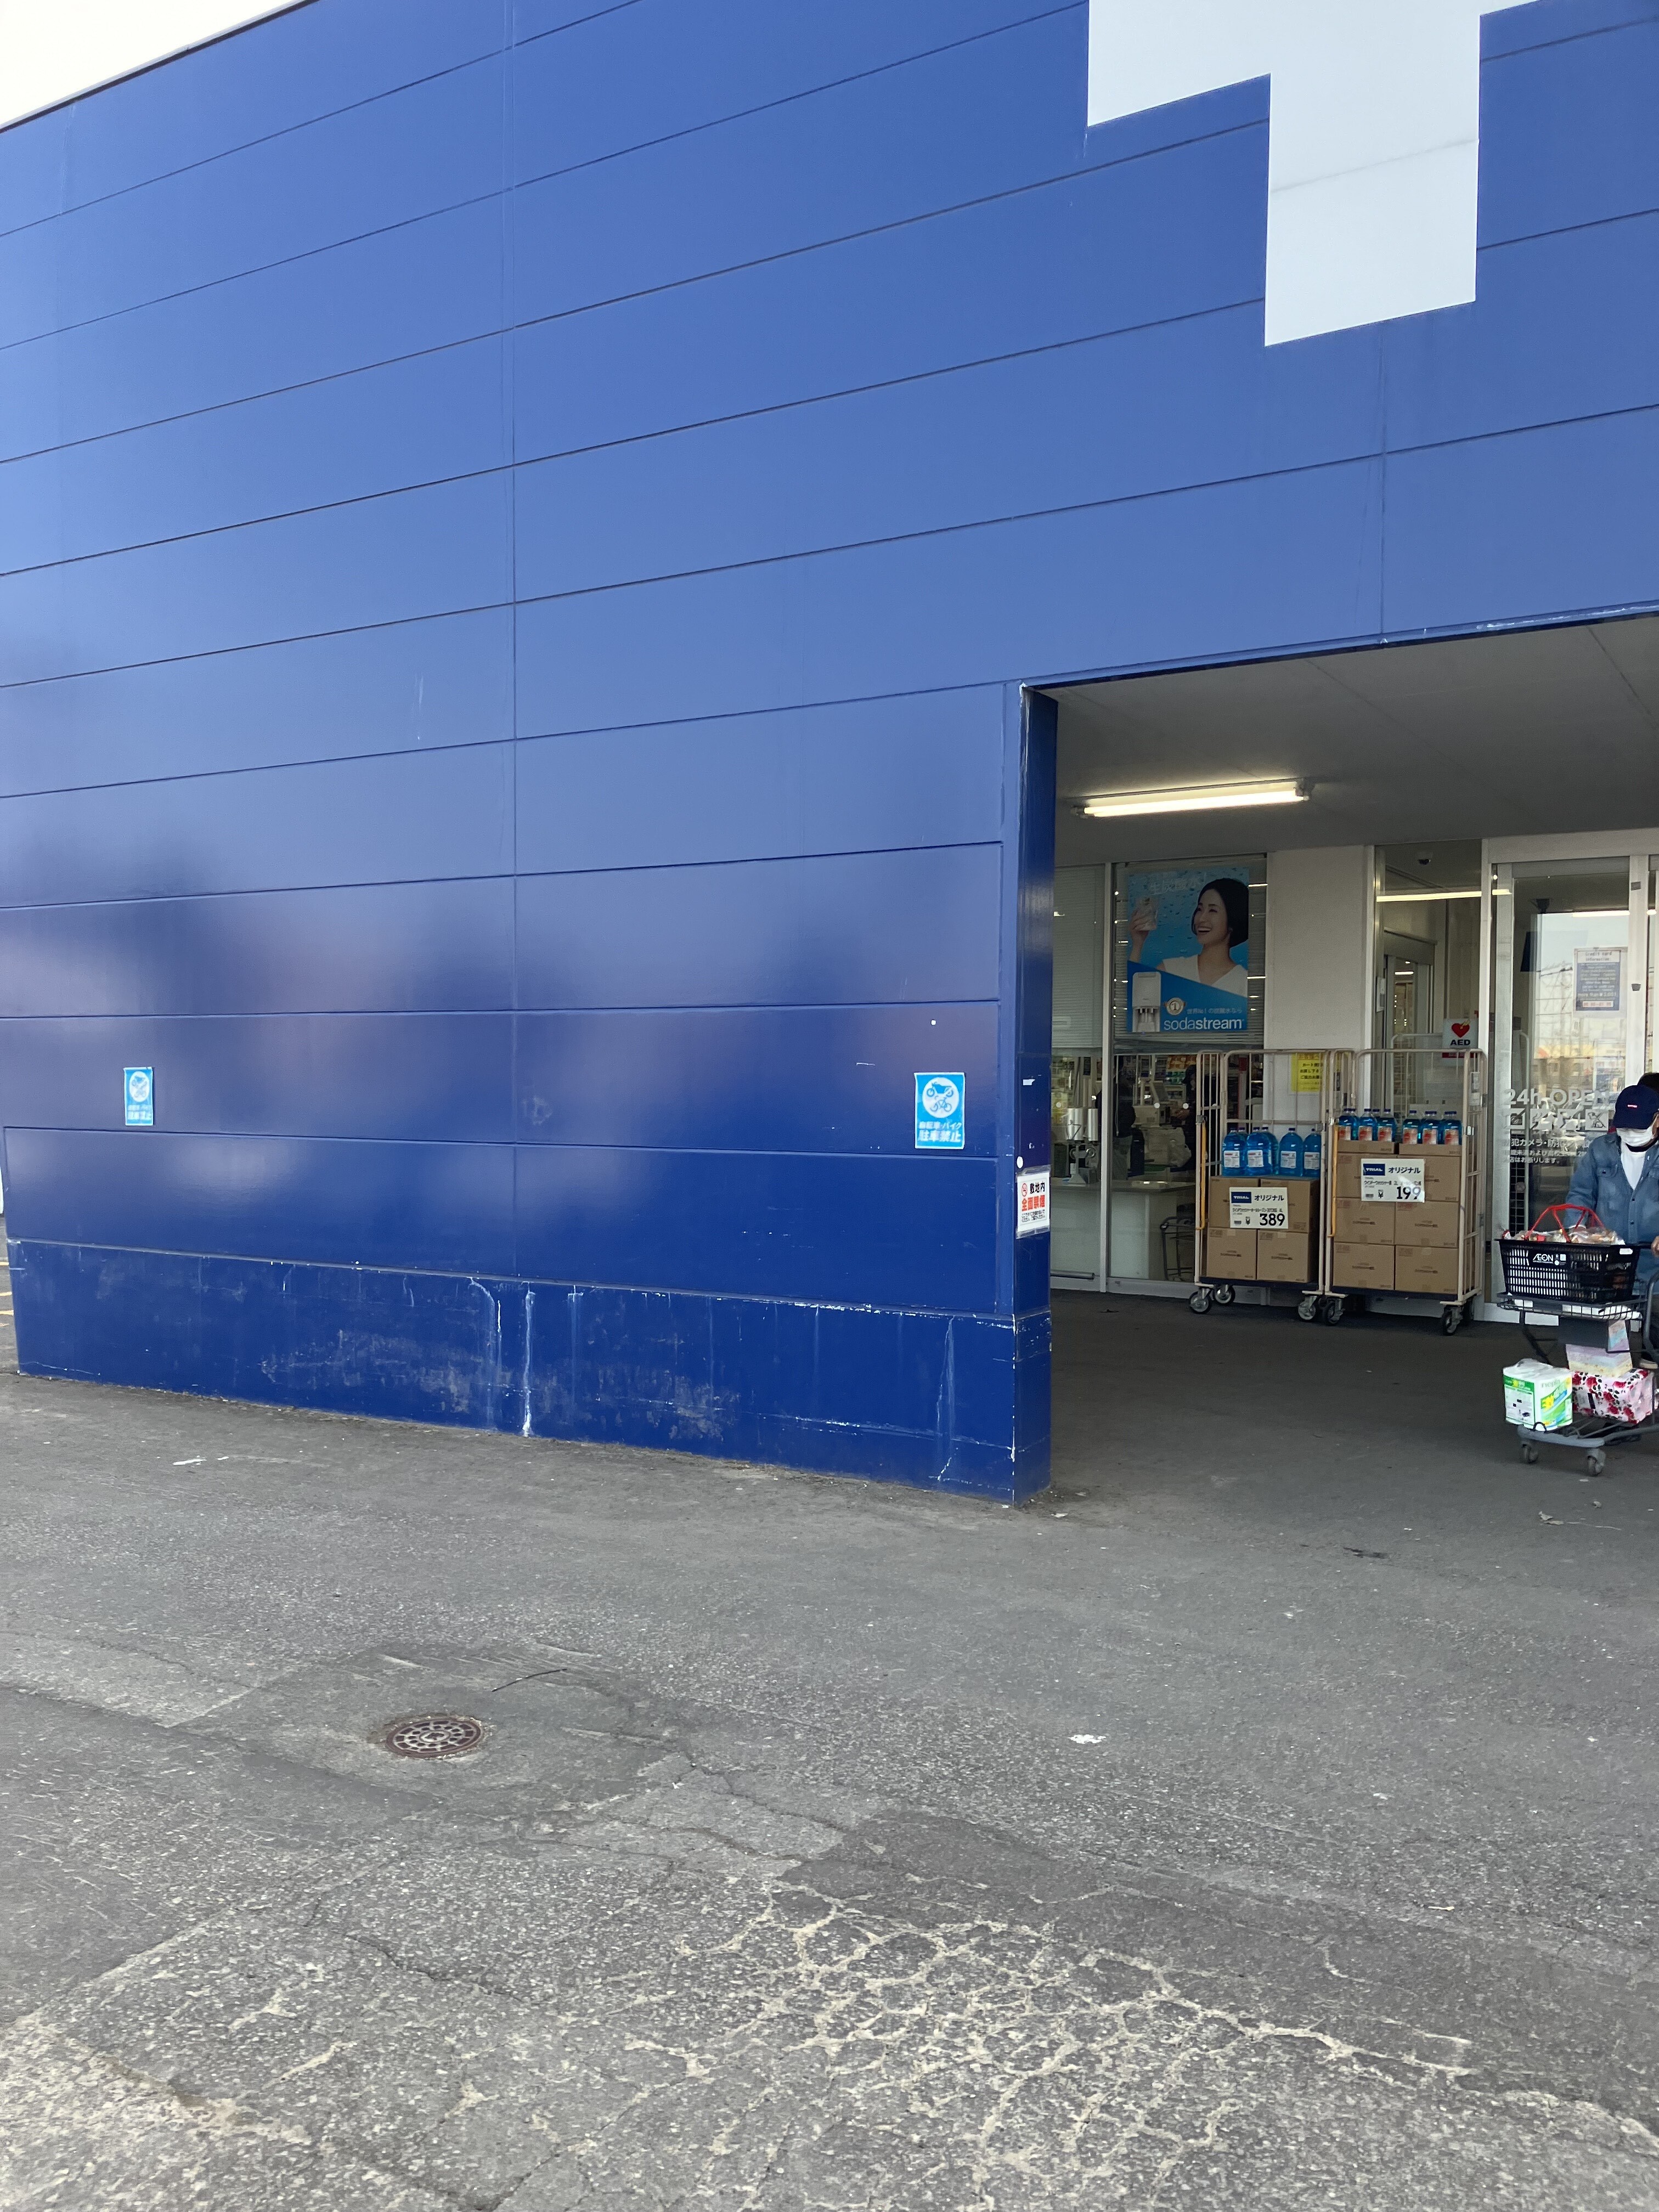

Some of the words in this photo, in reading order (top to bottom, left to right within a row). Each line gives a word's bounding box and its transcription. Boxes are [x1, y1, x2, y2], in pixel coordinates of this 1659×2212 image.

[1164, 1017, 1242, 1030] sodastream
[1505, 1088, 1541, 1105] 24h
[918, 1130, 961, 1142] 駐車禁止
[1029, 1182, 1045, 1194] 敷地内
[1397, 1186, 1421, 1200] 199
[1022, 1195, 1045, 1212] 全面禁煙
[1259, 1213, 1285, 1226] 389
